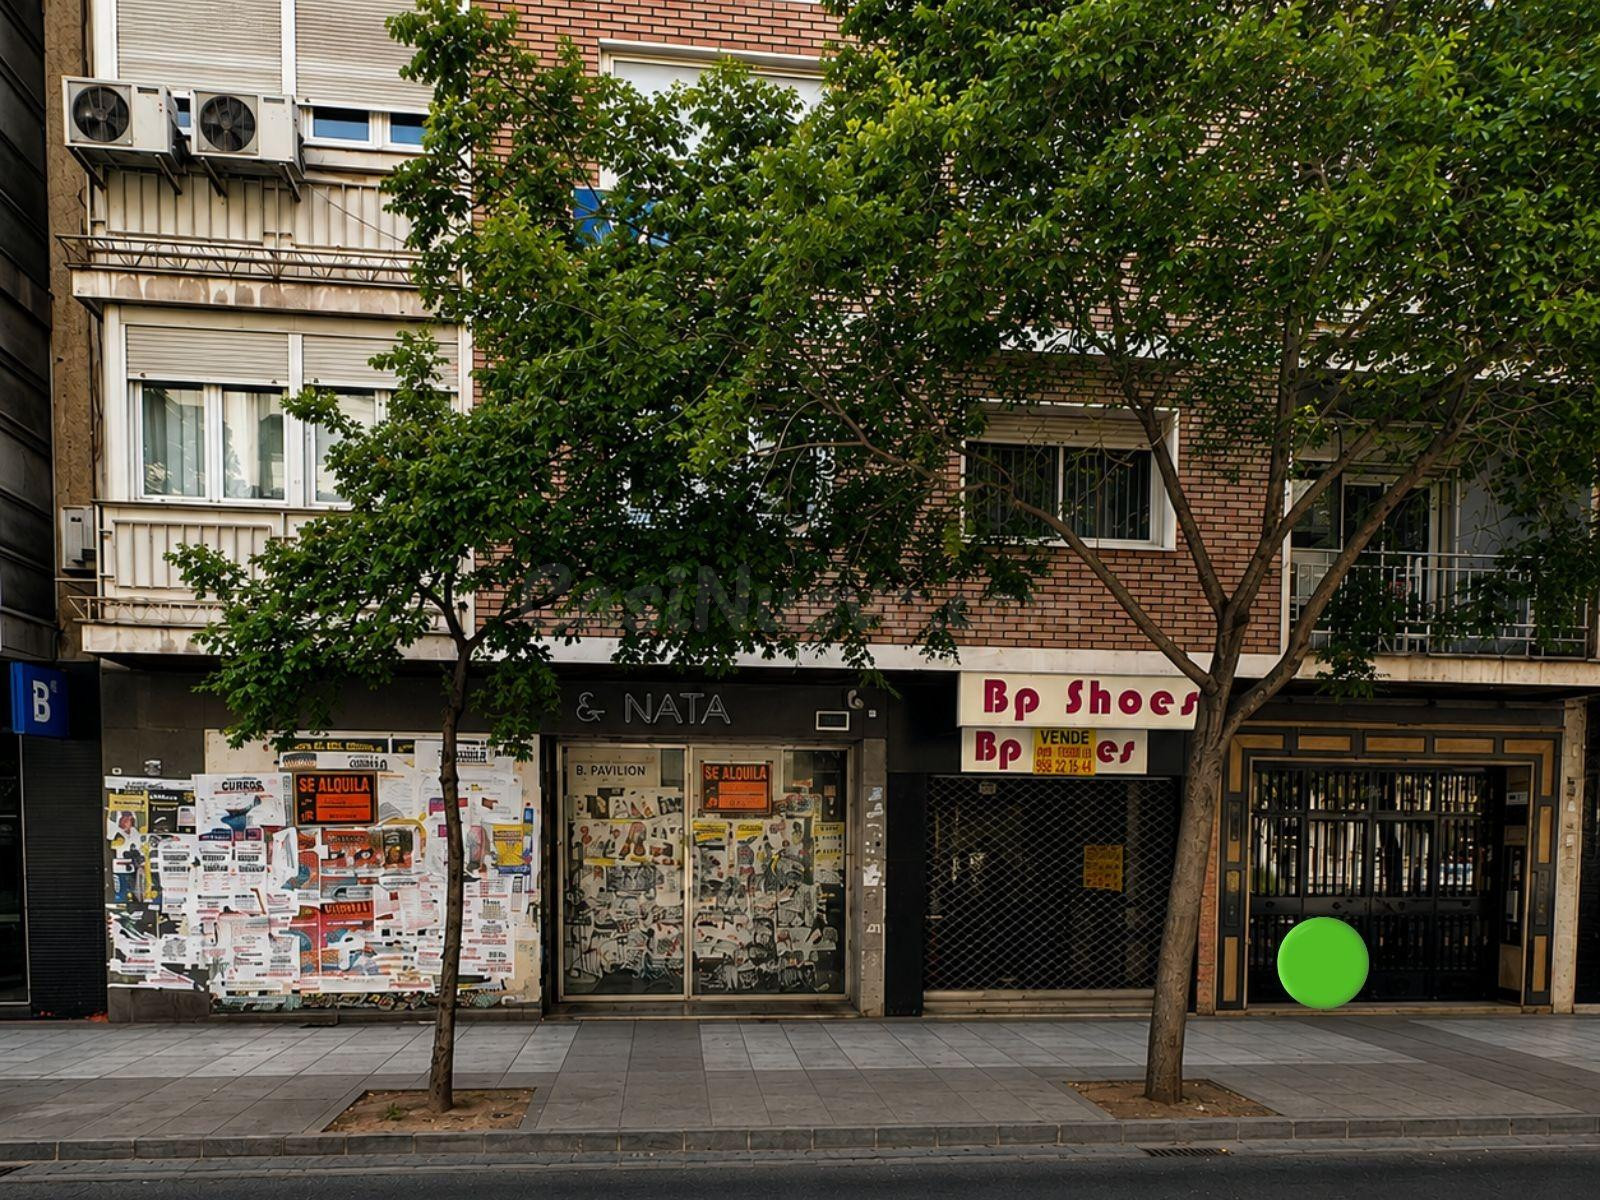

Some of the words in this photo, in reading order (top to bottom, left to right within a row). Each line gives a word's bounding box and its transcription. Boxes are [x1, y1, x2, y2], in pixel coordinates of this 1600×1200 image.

[576, 692, 606, 723] &
[624, 692, 731, 725] NATA
[983, 679, 1041, 721] Bp
[1065, 680, 1199, 717] Shoes
[1040, 730, 1089, 745] VENDE
[975, 731, 1022, 770] Bp
[591, 765, 646, 777] PAVILION
[704, 765, 720, 780] SE
[721, 765, 768, 781] ALQUILA
[299, 777, 315, 793] SE
[318, 777, 370, 794] ALQUILA
